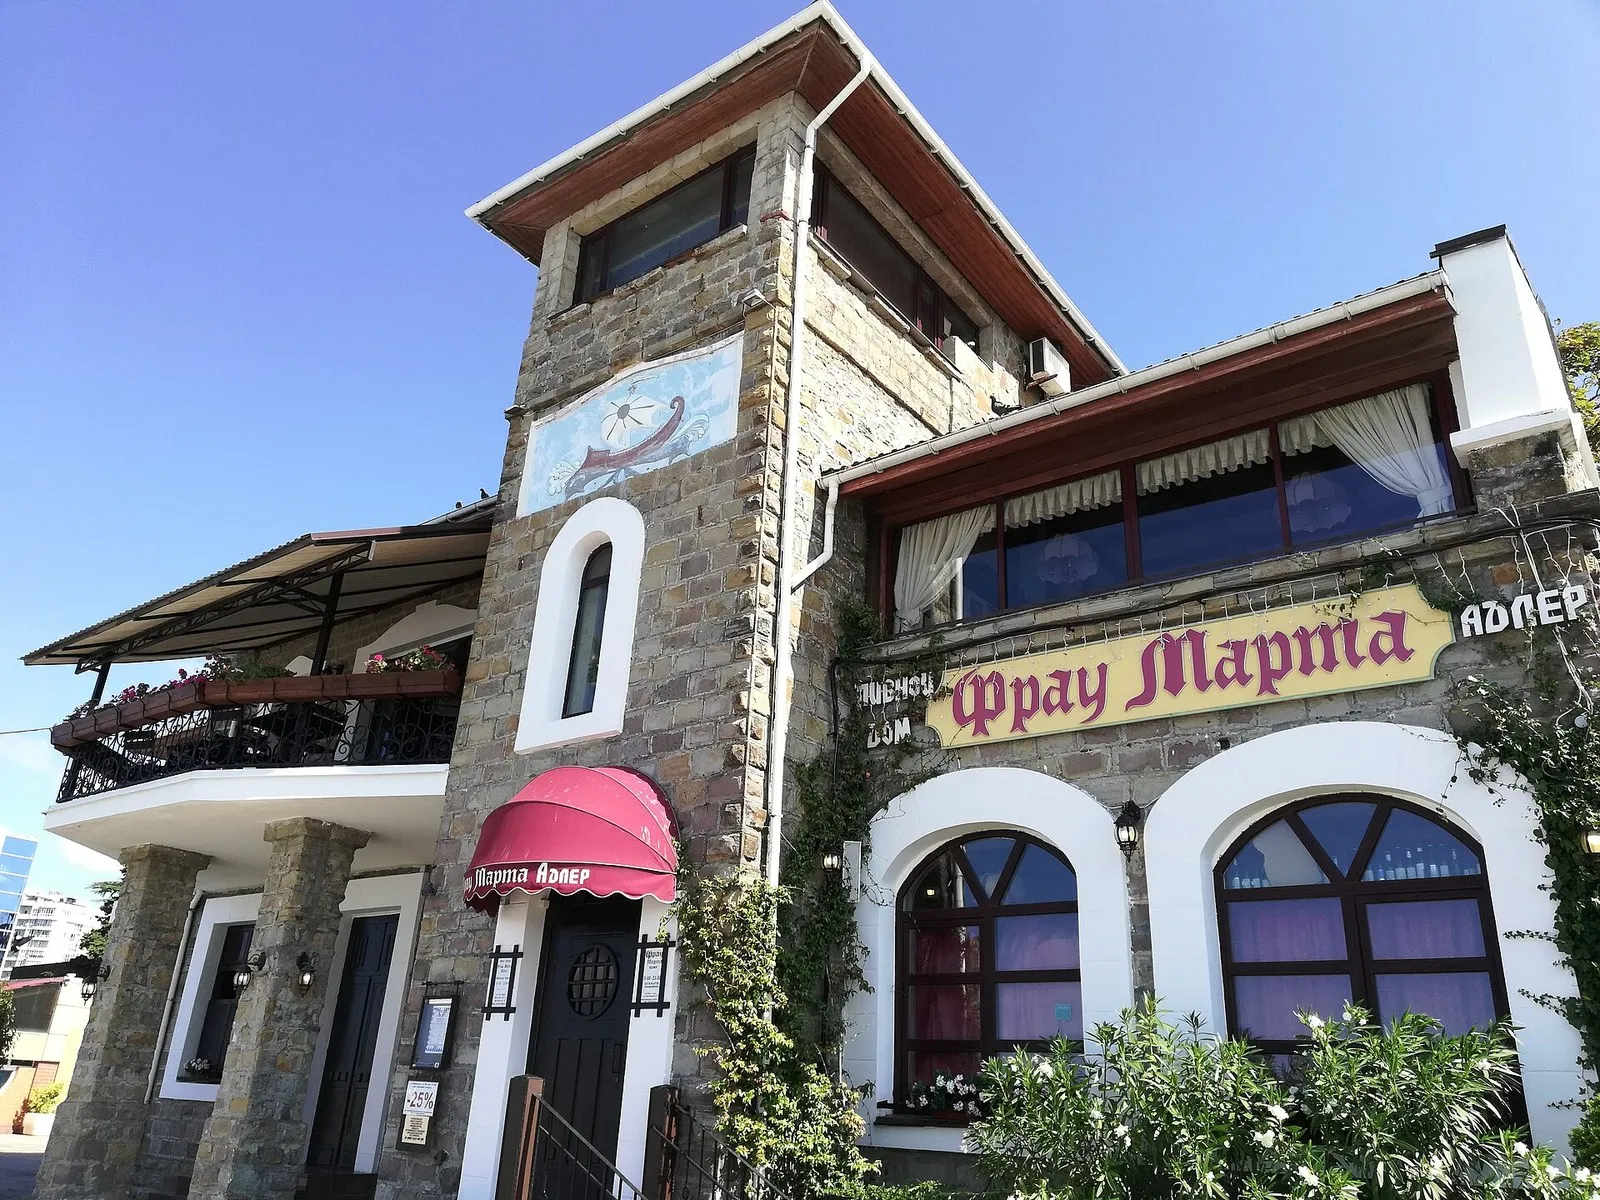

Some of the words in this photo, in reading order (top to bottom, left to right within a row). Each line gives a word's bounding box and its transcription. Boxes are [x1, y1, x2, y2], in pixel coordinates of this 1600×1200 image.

[1460, 585, 1588, 637] АДЛЕР
[951, 662, 1109, 737] Фрау
[1125, 608, 1416, 711] Марта
[473, 867, 529, 892] Марта
[407, 1091, 434, 1109] -25%
